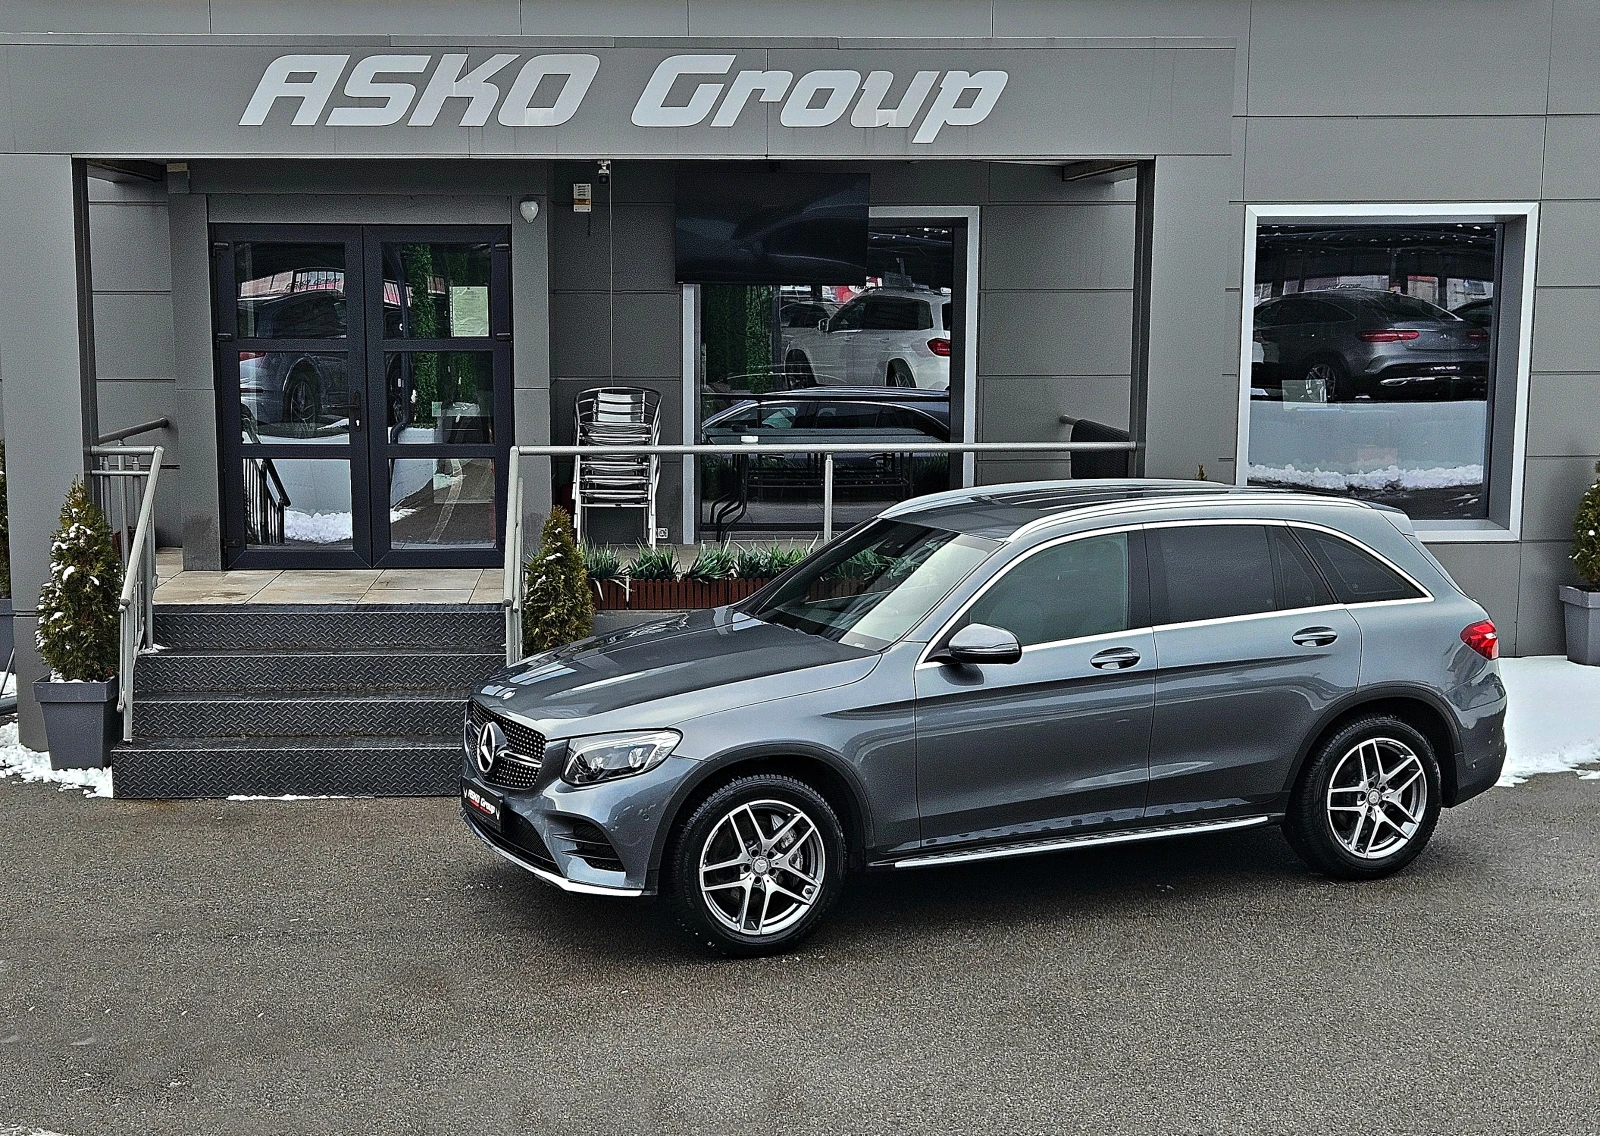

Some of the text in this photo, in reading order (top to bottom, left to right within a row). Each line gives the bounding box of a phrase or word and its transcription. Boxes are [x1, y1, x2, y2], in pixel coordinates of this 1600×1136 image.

[238, 54, 1009, 144] ASKO Group
[480, 797, 496, 815] Group
